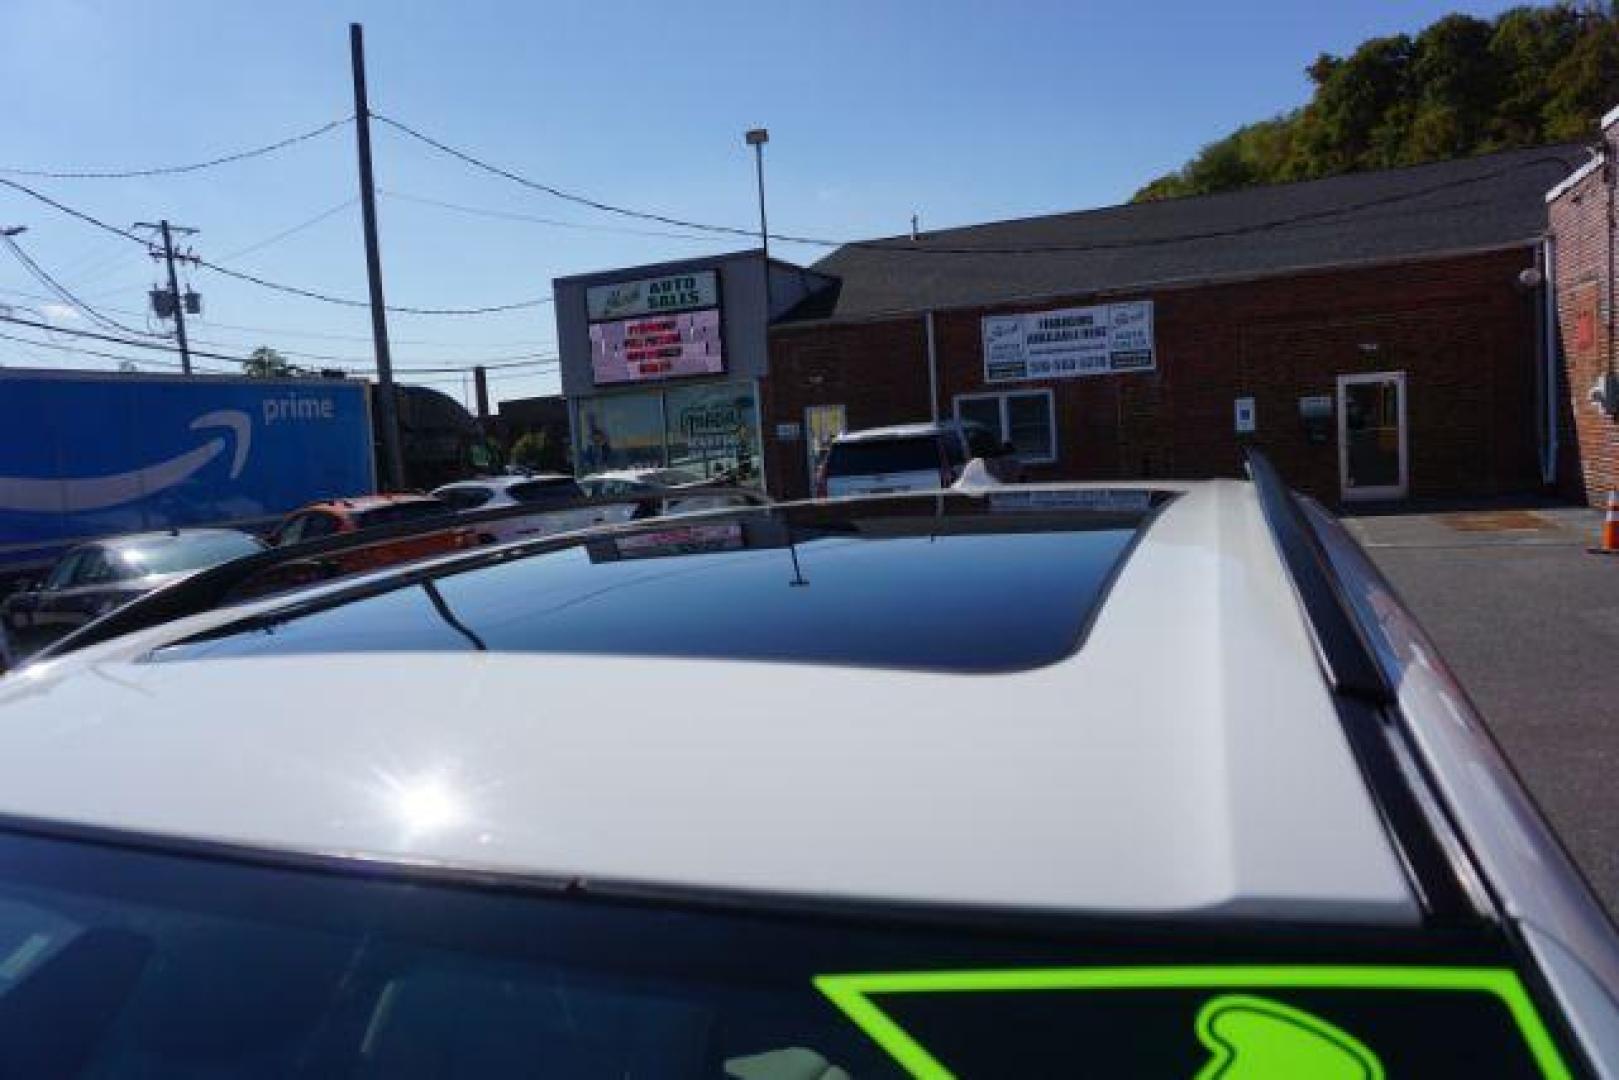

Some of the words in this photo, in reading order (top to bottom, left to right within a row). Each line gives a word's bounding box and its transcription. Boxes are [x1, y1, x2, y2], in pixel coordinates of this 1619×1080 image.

[649, 277, 697, 295] AUTO
[647, 290, 699, 309] SALES
[262, 393, 335, 425] prime
